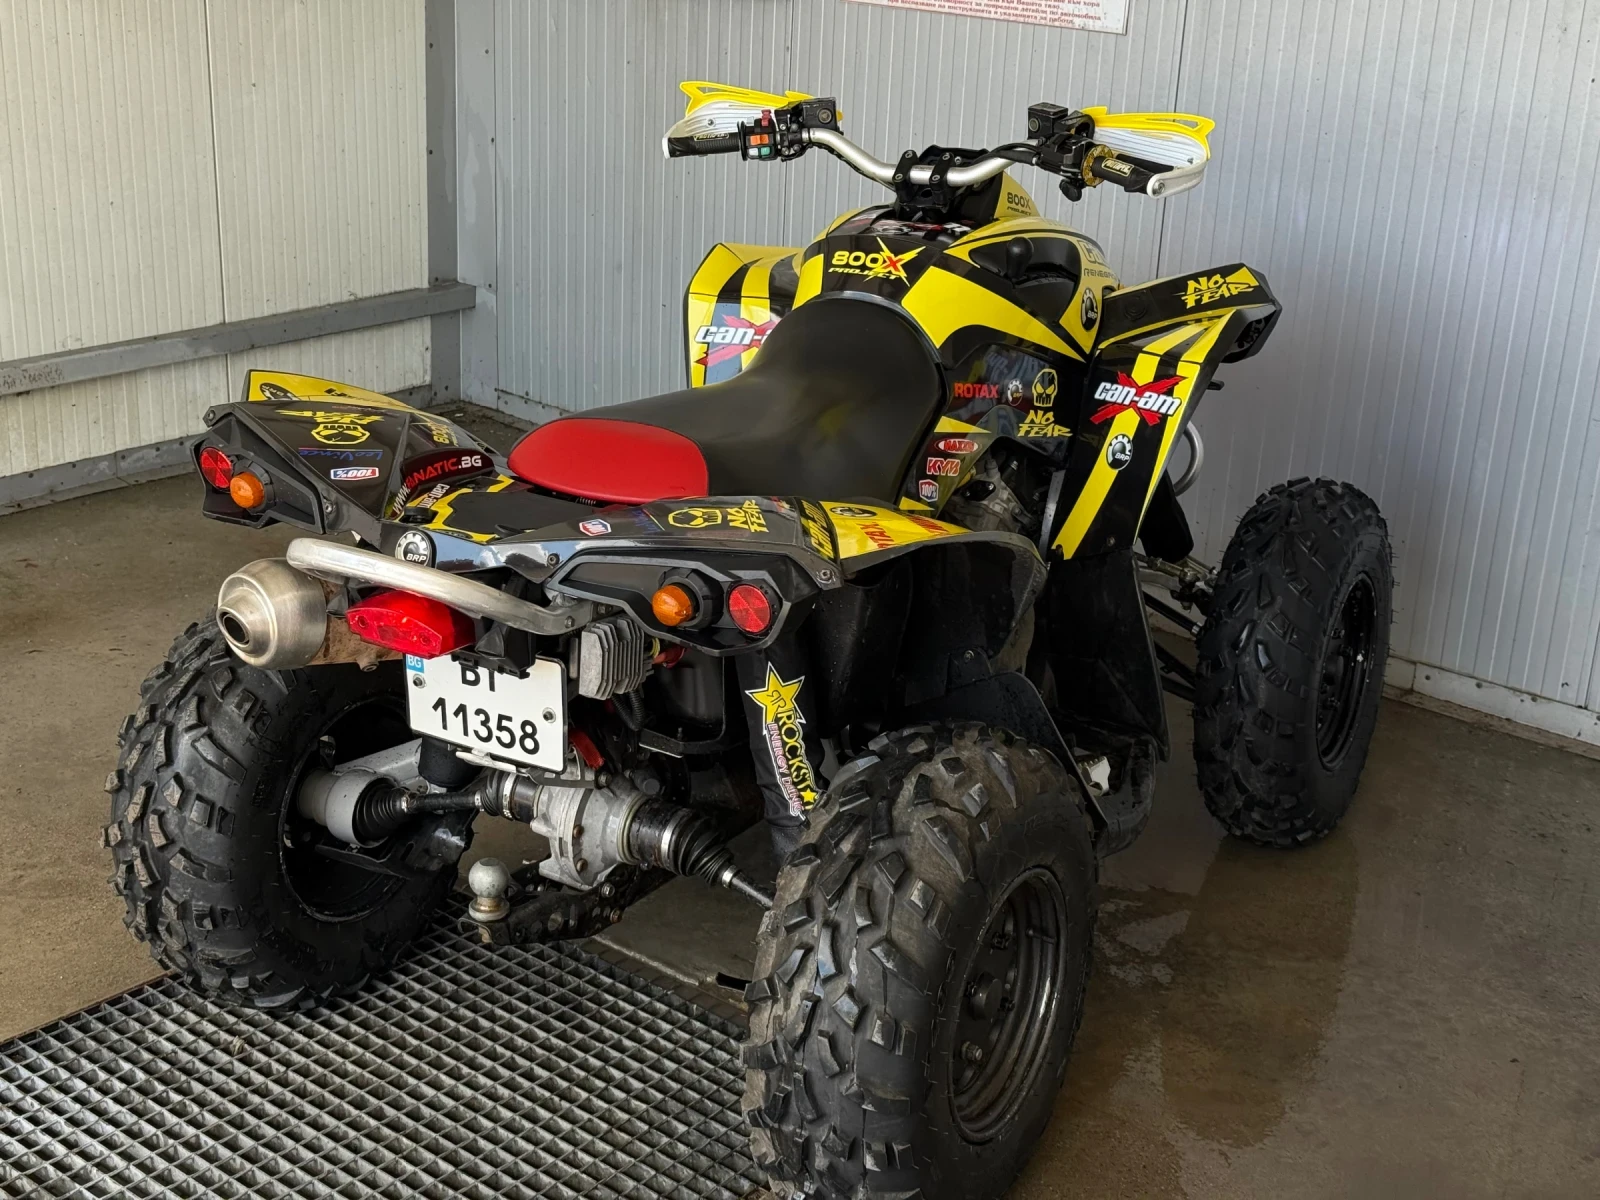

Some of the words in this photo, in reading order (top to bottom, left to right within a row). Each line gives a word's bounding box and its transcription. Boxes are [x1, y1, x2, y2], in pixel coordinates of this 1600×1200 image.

[1006, 191, 1032, 211] 800X
[831, 245, 915, 278] 800X
[828, 267, 900, 280] PROJECT
[1186, 273, 1225, 295] NO
[1181, 283, 1255, 310] FEAR
[954, 382, 1000, 399] ROTAX
[1094, 381, 1182, 416] can-am
[1024, 409, 1055, 424] NO
[1017, 423, 1073, 437] FEAR
[1114, 452, 1130, 461] BRP
[337, 470, 373, 479] 100%
[926, 457, 961, 477] KYB
[406, 553, 427, 564] BRP
[407, 656, 422, 668] BG
[432, 697, 540, 755] 11358
[767, 722, 791, 775] ENERGY
